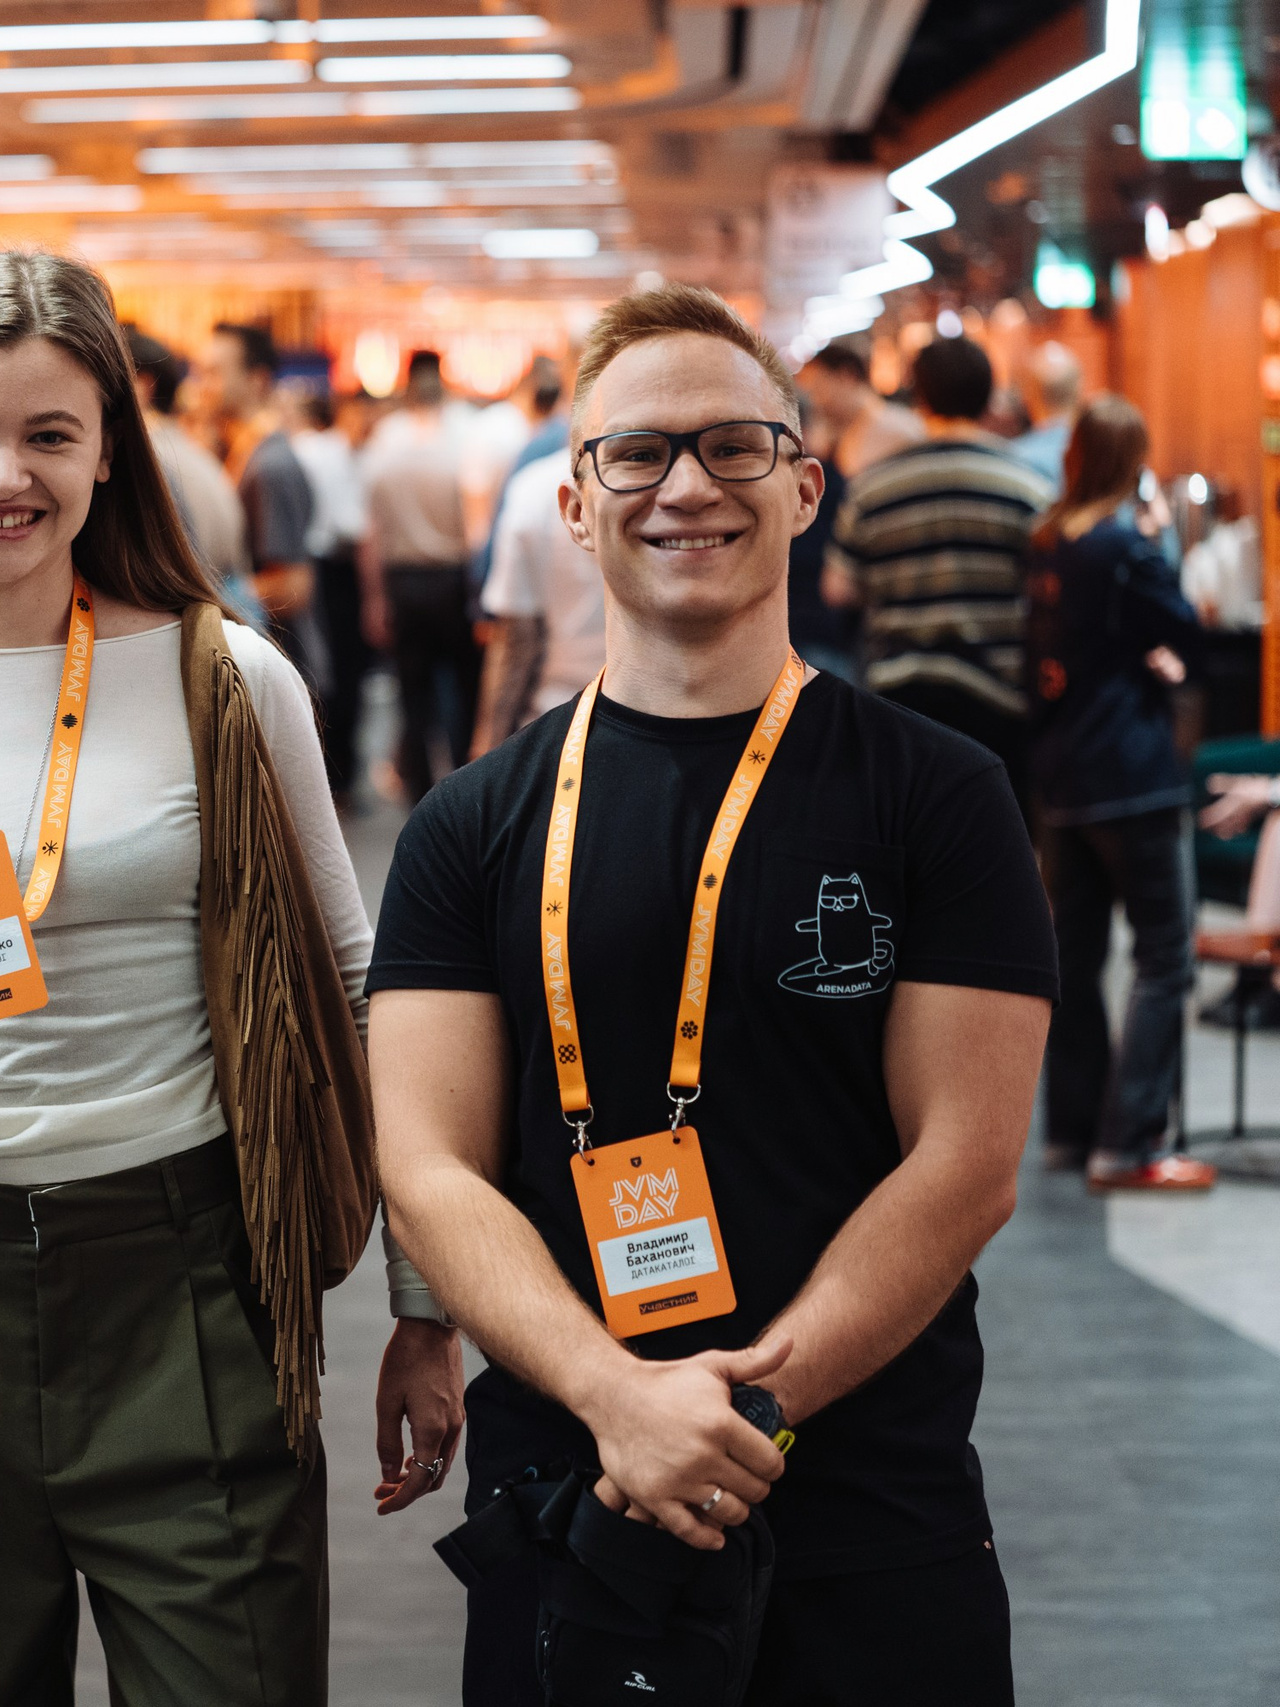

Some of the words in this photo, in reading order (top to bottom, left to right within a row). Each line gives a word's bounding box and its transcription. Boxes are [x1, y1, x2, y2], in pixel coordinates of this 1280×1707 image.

[72, 619, 90, 657] DAY
[66, 658, 86, 702] JVM
[775, 668, 799, 707] JVM
[759, 703, 786, 743] DAY
[53, 741, 73, 782] DAY
[47, 784, 67, 829] JVM
[726, 774, 754, 817] JVM
[553, 804, 572, 842] DAY
[711, 816, 737, 860] DAY
[549, 842, 568, 887] JVM
[691, 904, 712, 955] JVM
[546, 932, 563, 978] DAY
[686, 958, 706, 1007] DAY
[816, 982, 872, 994] ARENADATA
[549, 980, 571, 1030] JVM
[609, 1167, 679, 1206] JVM
[614, 1191, 679, 1229] DAY
[626, 1243, 695, 1267] Баханович
[627, 1231, 689, 1254] Владимир
[631, 1256, 696, 1280] ДАТАКАТАЛОГ
[639, 1293, 698, 1314] Участник
